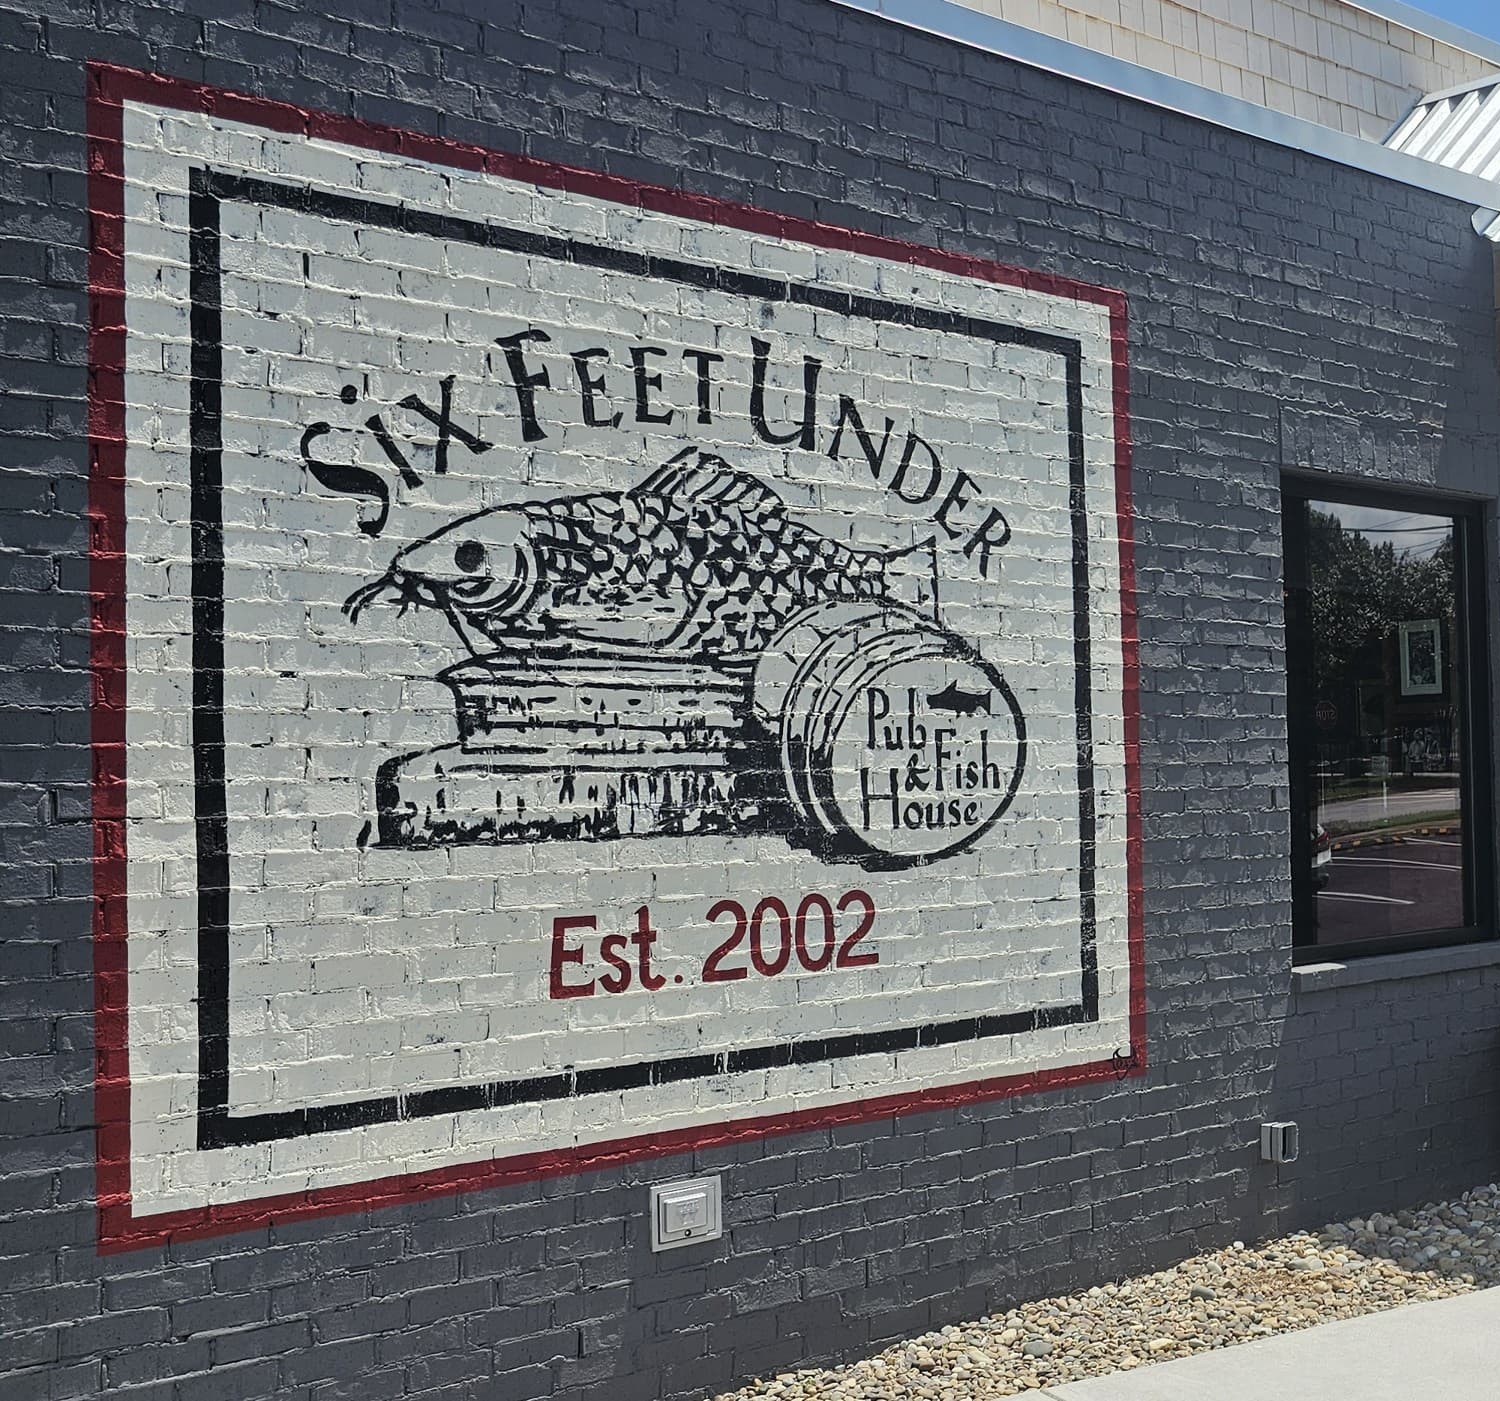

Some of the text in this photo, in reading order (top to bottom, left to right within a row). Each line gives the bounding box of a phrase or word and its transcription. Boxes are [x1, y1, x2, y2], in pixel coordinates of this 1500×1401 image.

[494, 328, 724, 442] FEET
[749, 333, 1012, 579] UNDER
[866, 687, 927, 751] Pub
[903, 727, 1001, 793] & Fish
[860, 766, 980, 831] House
[549, 889, 880, 1000] Est. 2002
